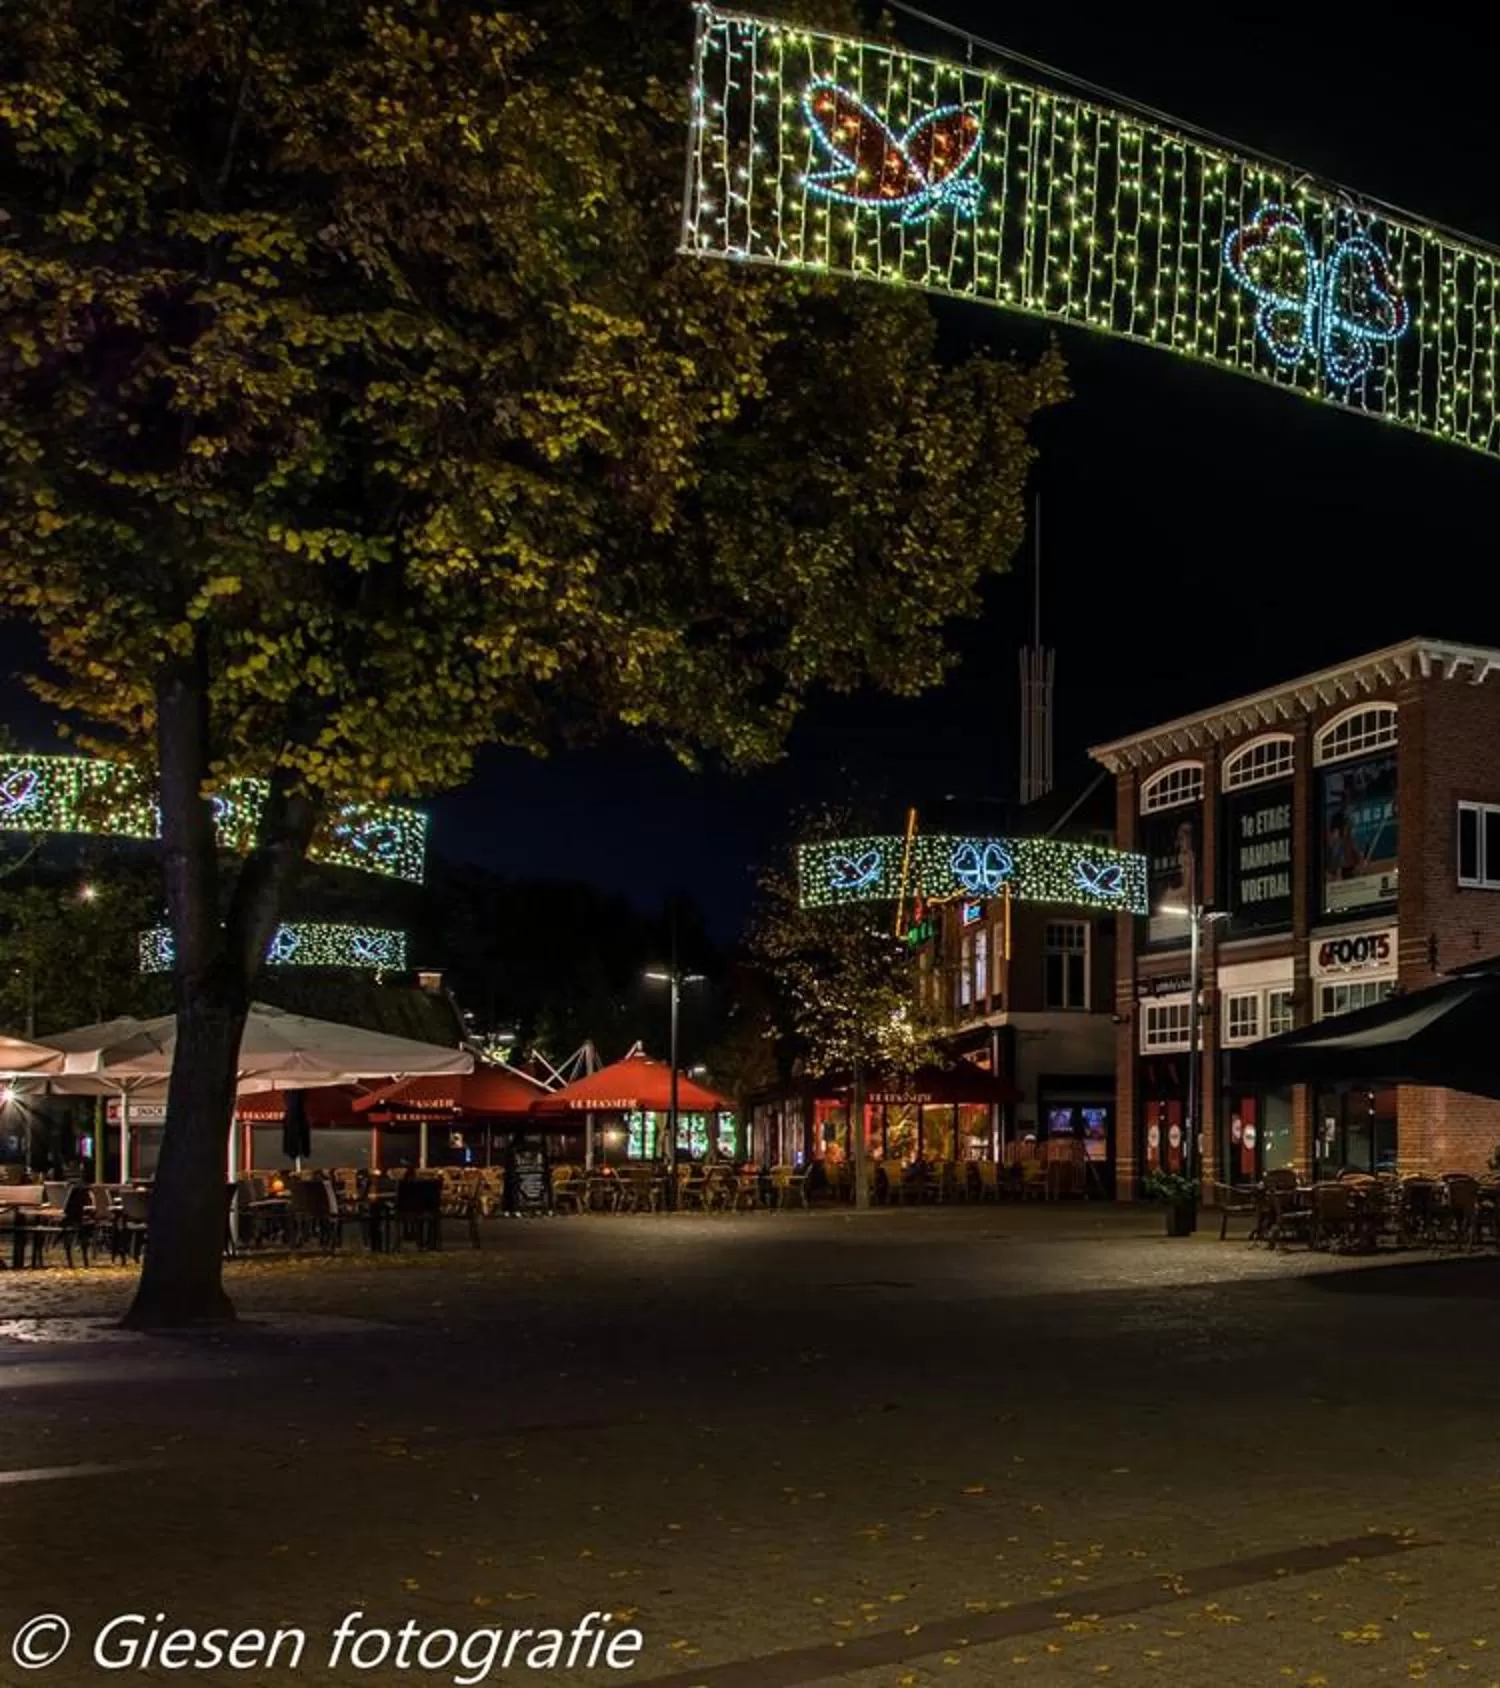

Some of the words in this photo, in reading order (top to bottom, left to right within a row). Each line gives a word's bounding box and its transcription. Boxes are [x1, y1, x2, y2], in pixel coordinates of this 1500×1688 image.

[1256, 804, 1290, 834] ETAGE
[1240, 838, 1291, 870] HANDBAL
[1240, 871, 1290, 904] VOETBAL
